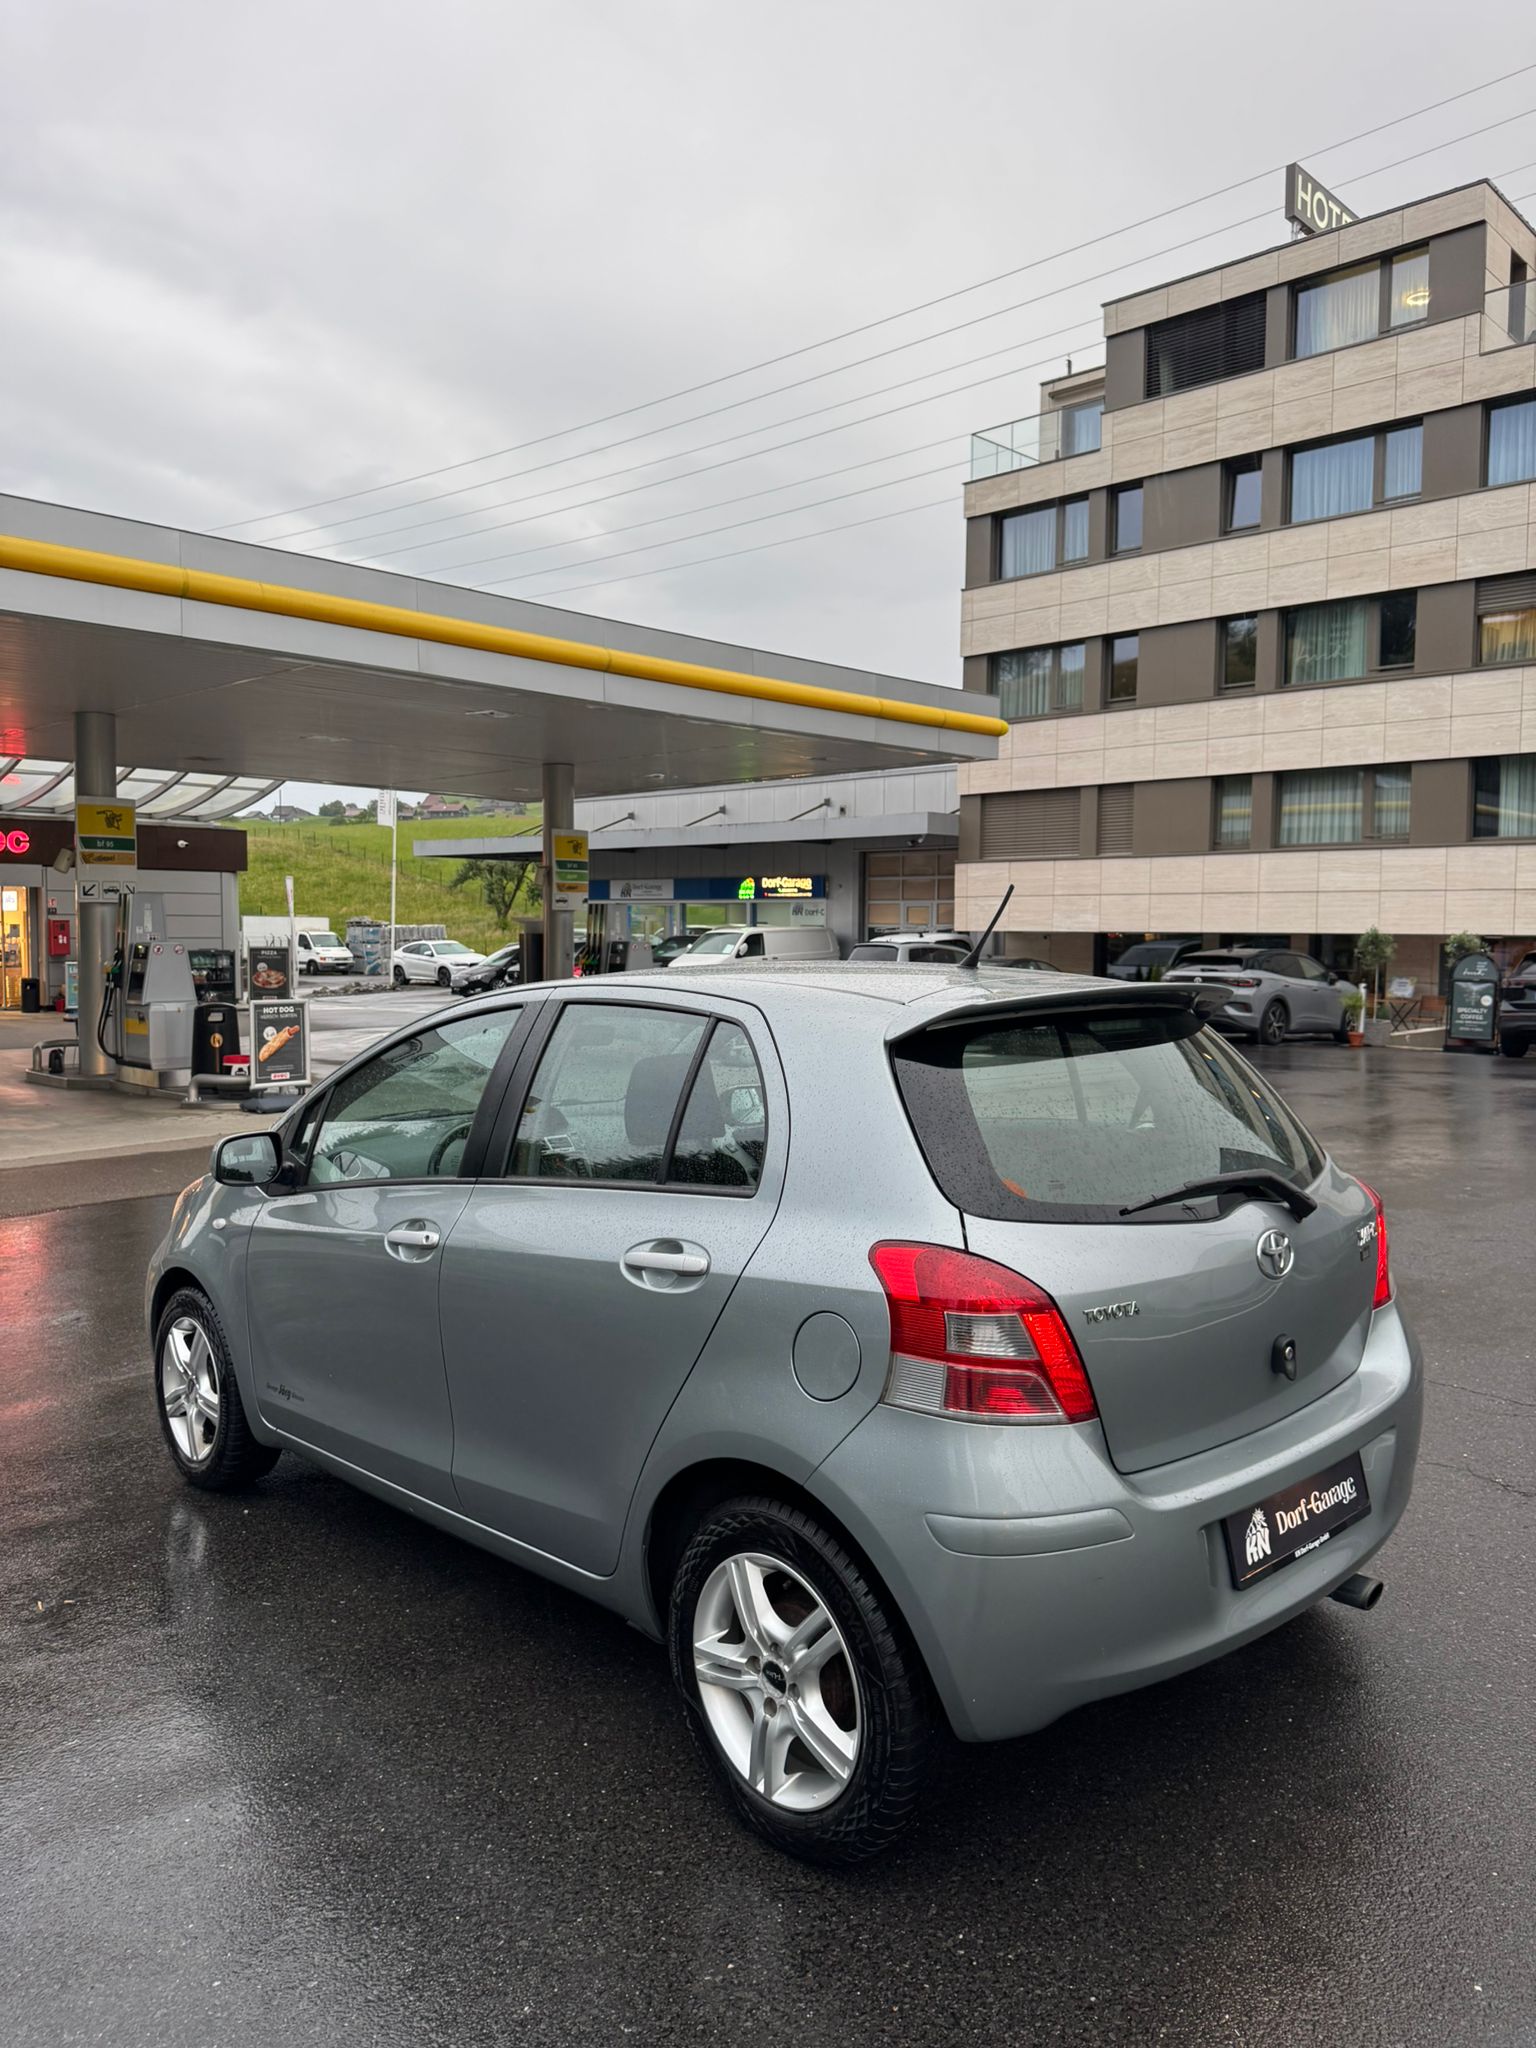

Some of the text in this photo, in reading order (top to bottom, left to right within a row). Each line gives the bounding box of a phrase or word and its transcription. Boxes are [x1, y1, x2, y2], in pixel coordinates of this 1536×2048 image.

[0, 830, 30, 854] c
[1082, 1301, 1140, 1325] TOYOTA
[1275, 1477, 1356, 1535] Dorf-Garage
